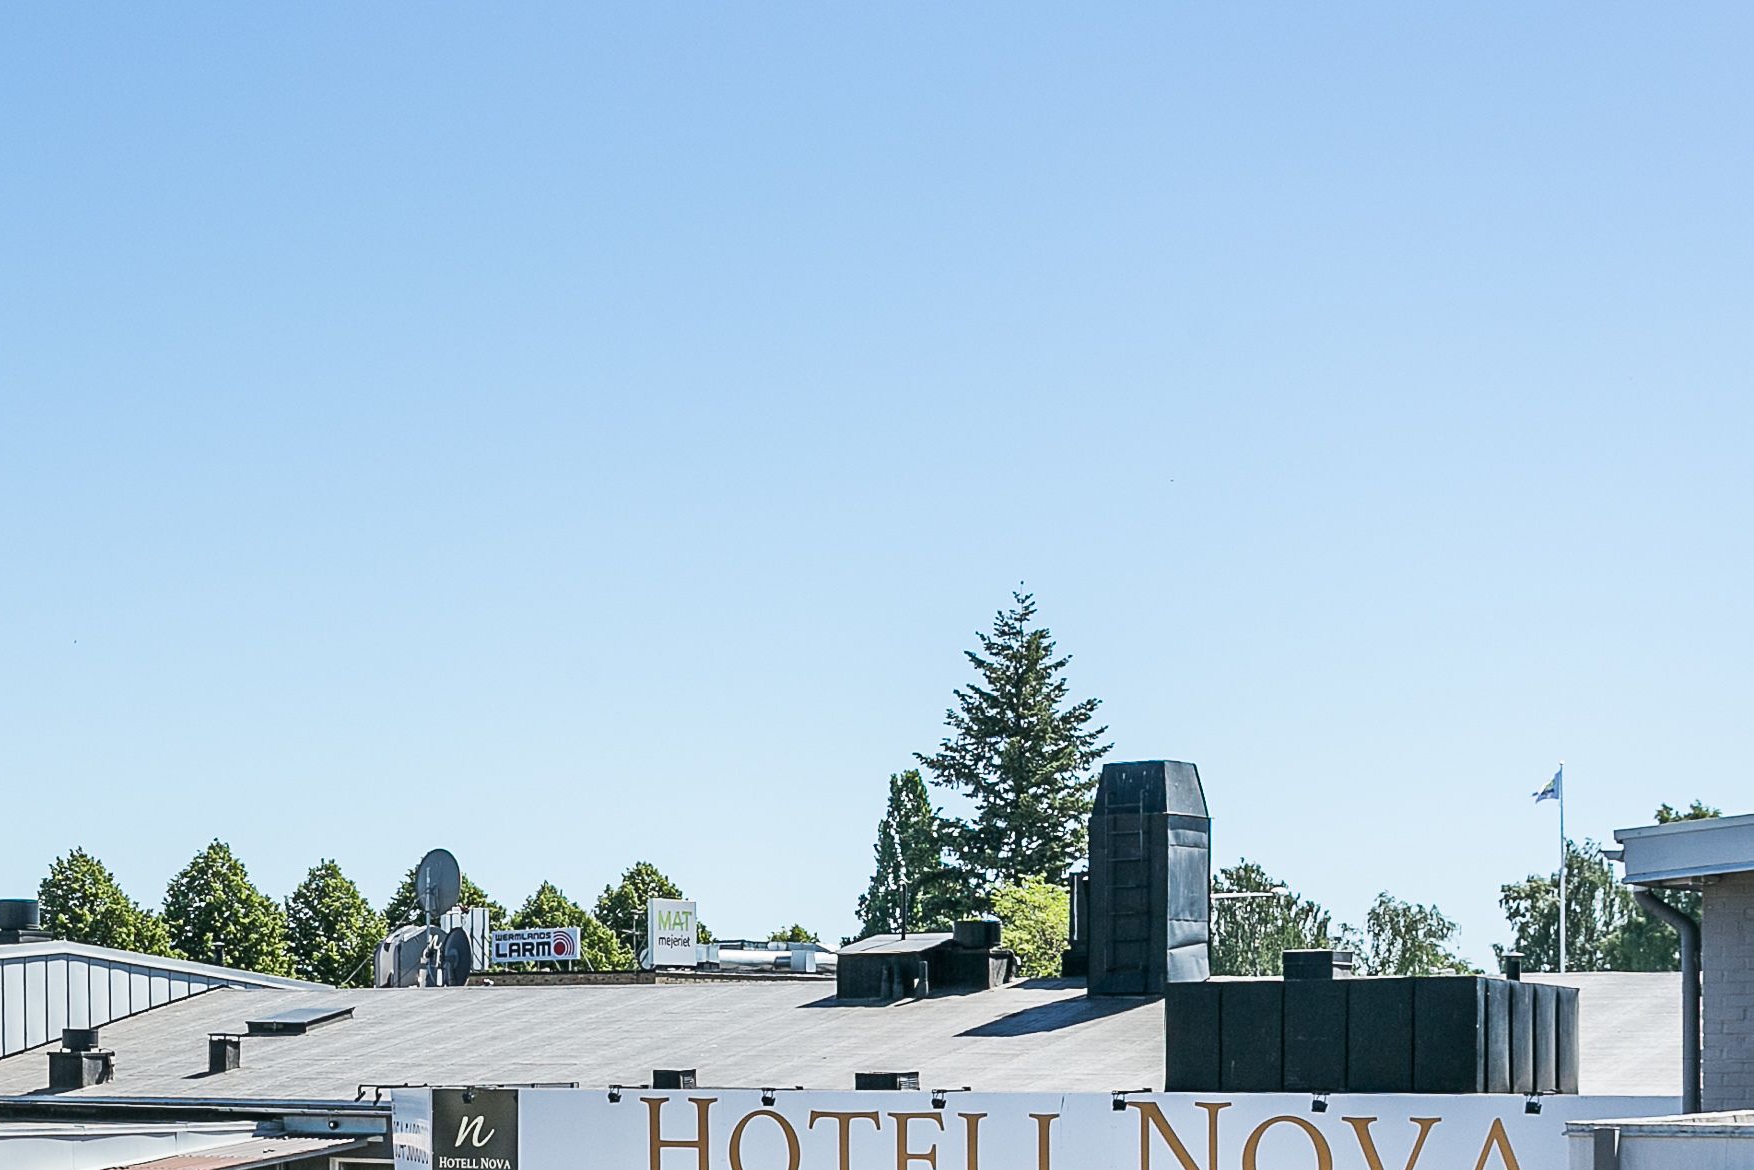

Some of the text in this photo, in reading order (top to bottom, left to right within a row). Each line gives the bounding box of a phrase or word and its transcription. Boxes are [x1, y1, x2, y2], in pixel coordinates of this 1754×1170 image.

[658, 911, 692, 931] MAT
[495, 932, 551, 941] WERMLANDS
[658, 934, 690, 949] mejeriet
[495, 941, 551, 958] LARM
[439, 1156, 511, 1170] HOTELL NOVA
